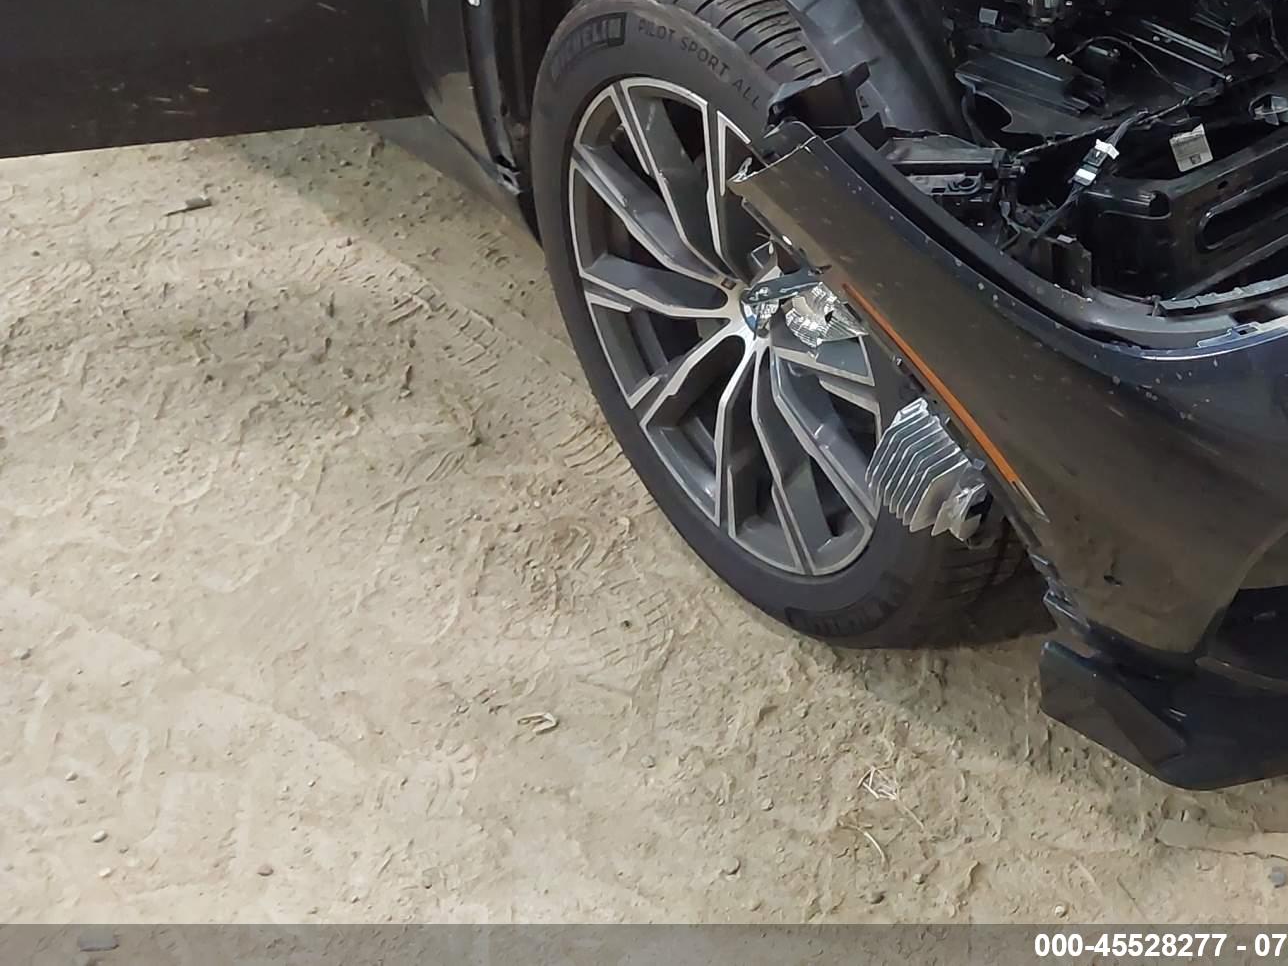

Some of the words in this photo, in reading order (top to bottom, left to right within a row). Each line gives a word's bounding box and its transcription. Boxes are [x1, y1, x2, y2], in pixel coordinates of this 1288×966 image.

[637, 18, 675, 42] PILOT
[681, 37, 730, 77] SPORT
[732, 79, 762, 112] ALL
